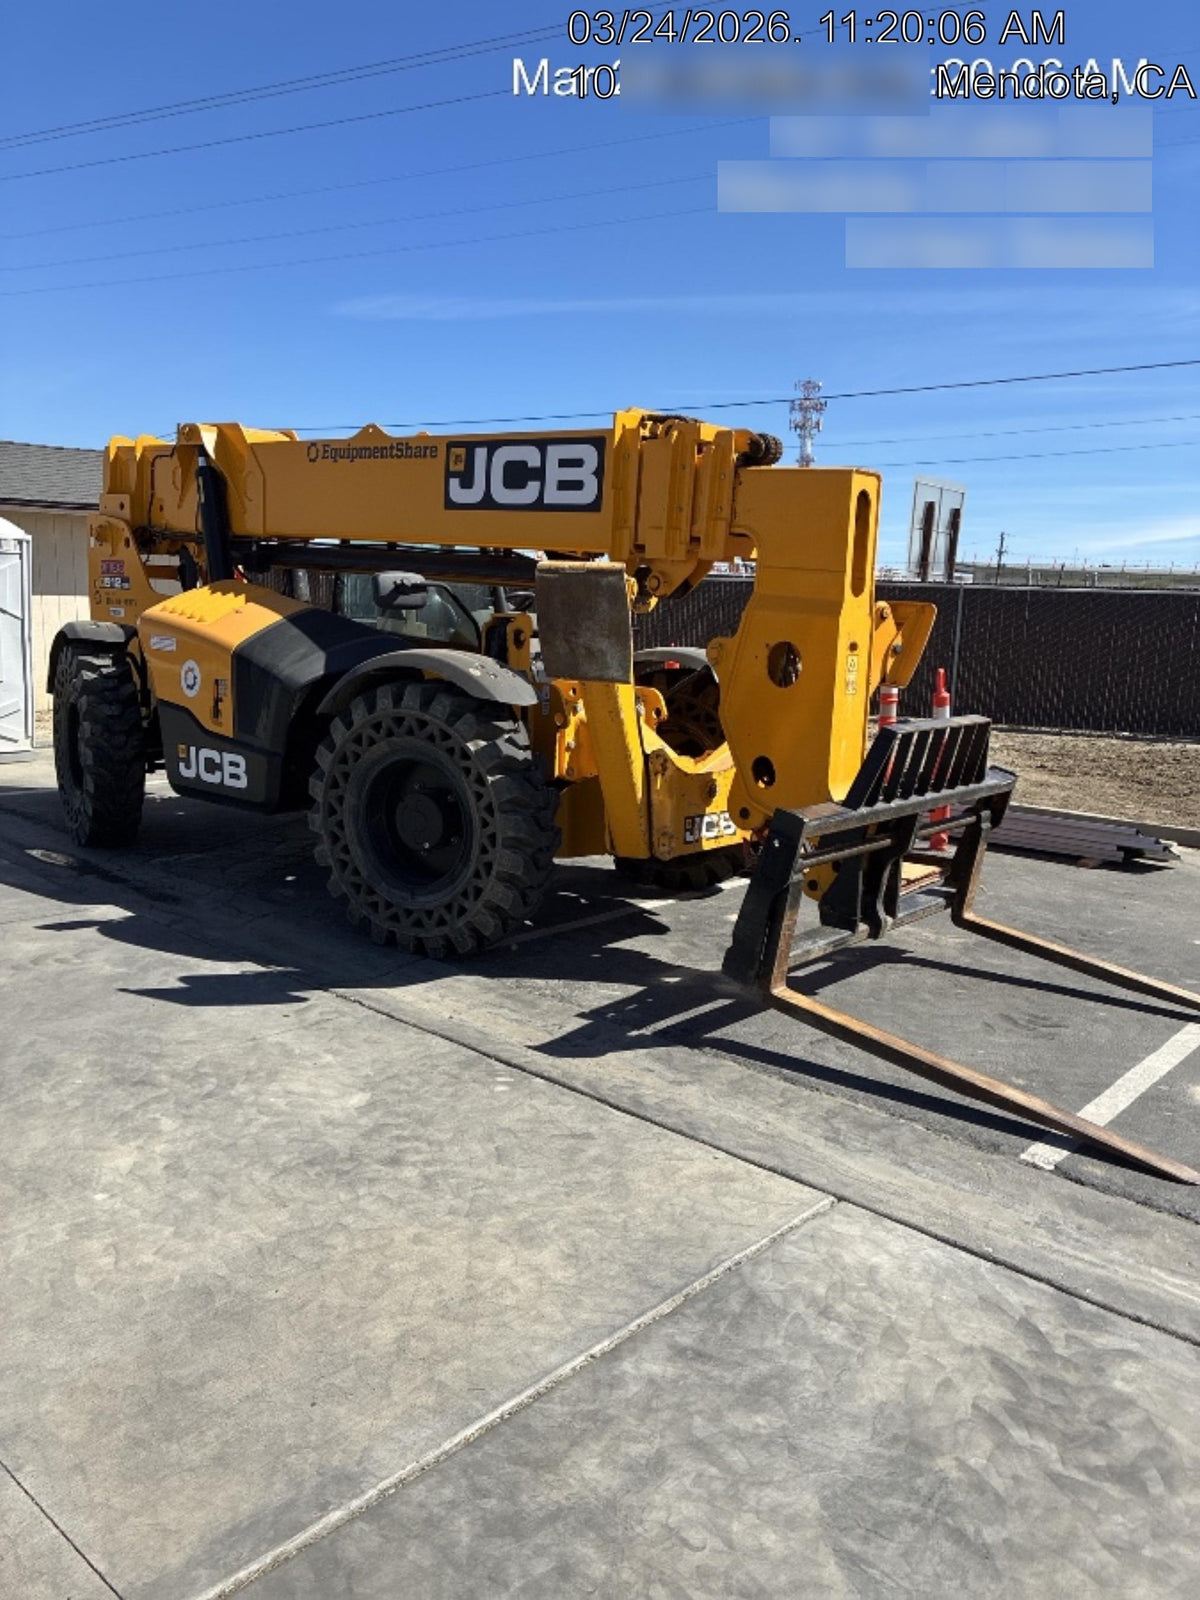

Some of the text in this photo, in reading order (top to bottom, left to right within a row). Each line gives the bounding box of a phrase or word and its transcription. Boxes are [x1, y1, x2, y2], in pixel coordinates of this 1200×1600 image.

[321, 442, 438, 463] EquipmentShare
[449, 443, 599, 505] JCB
[179, 746, 248, 789] JCB
